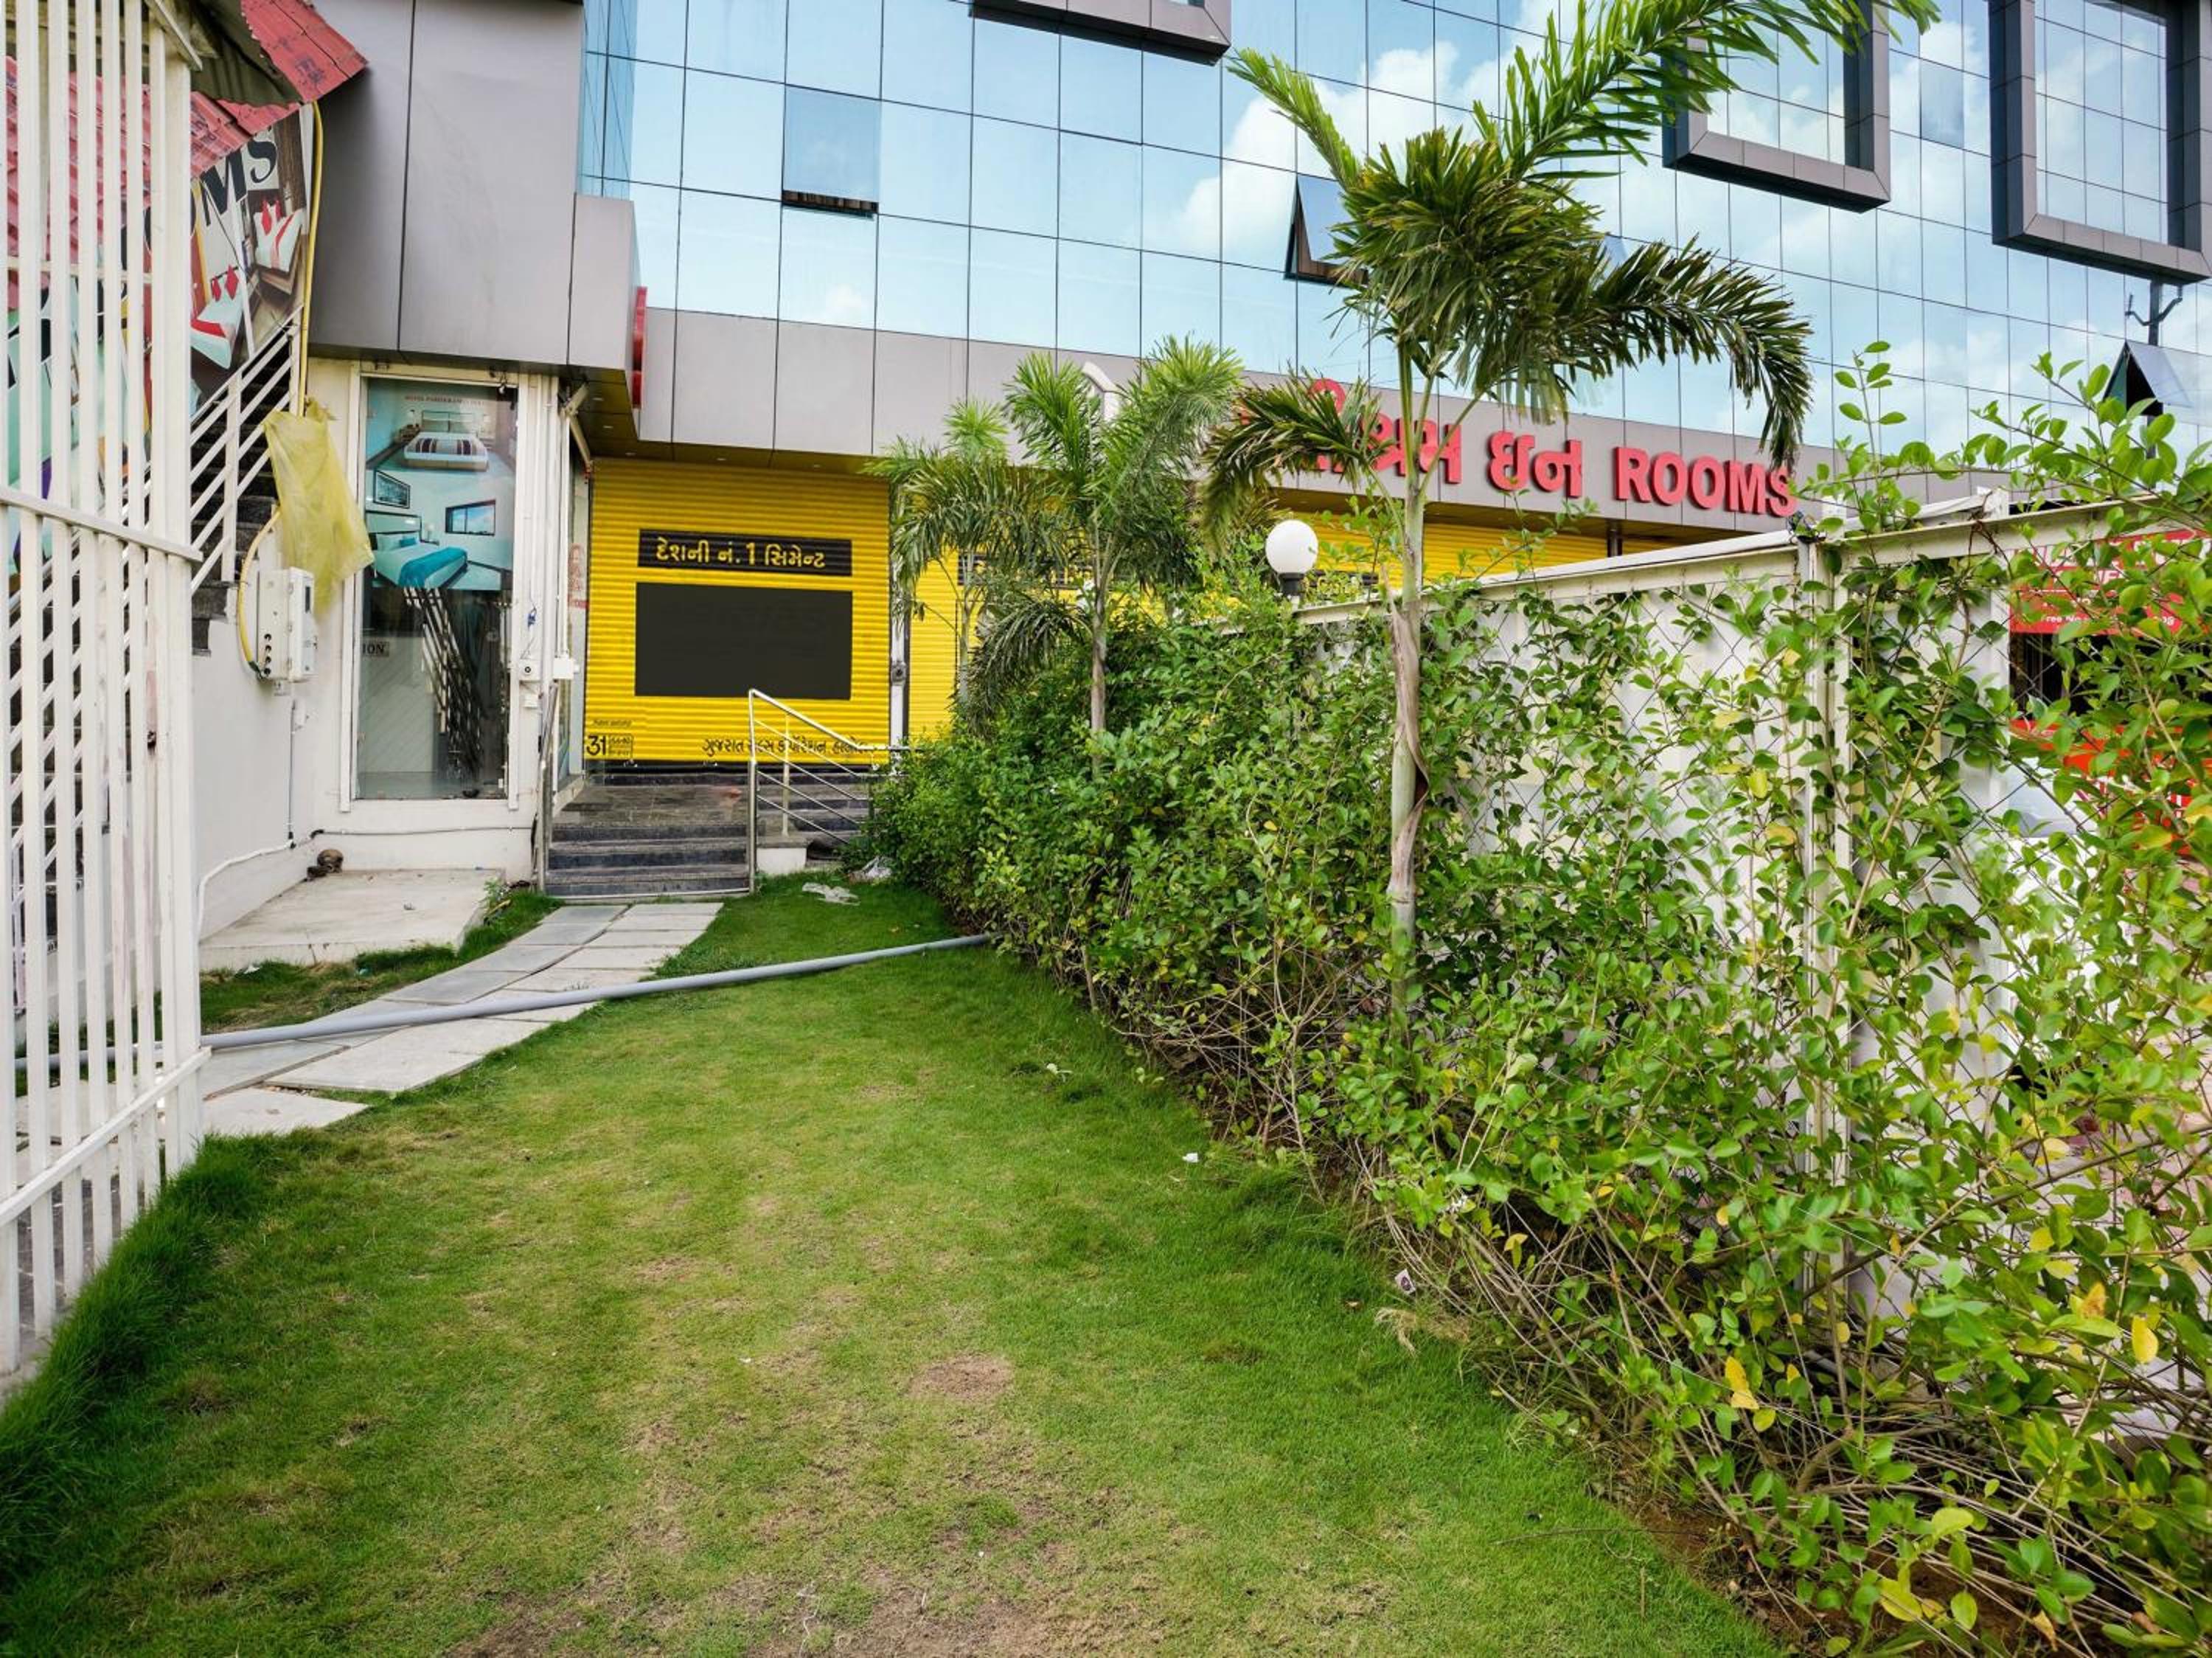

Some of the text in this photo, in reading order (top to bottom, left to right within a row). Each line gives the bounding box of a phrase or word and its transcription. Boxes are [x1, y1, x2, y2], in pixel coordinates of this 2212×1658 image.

[1614, 446, 1798, 518] ROOMS
[655, 536, 709, 564] દેશની
[764, 543, 826, 569] સિમેન્ટ
[586, 735, 607, 756] 31
